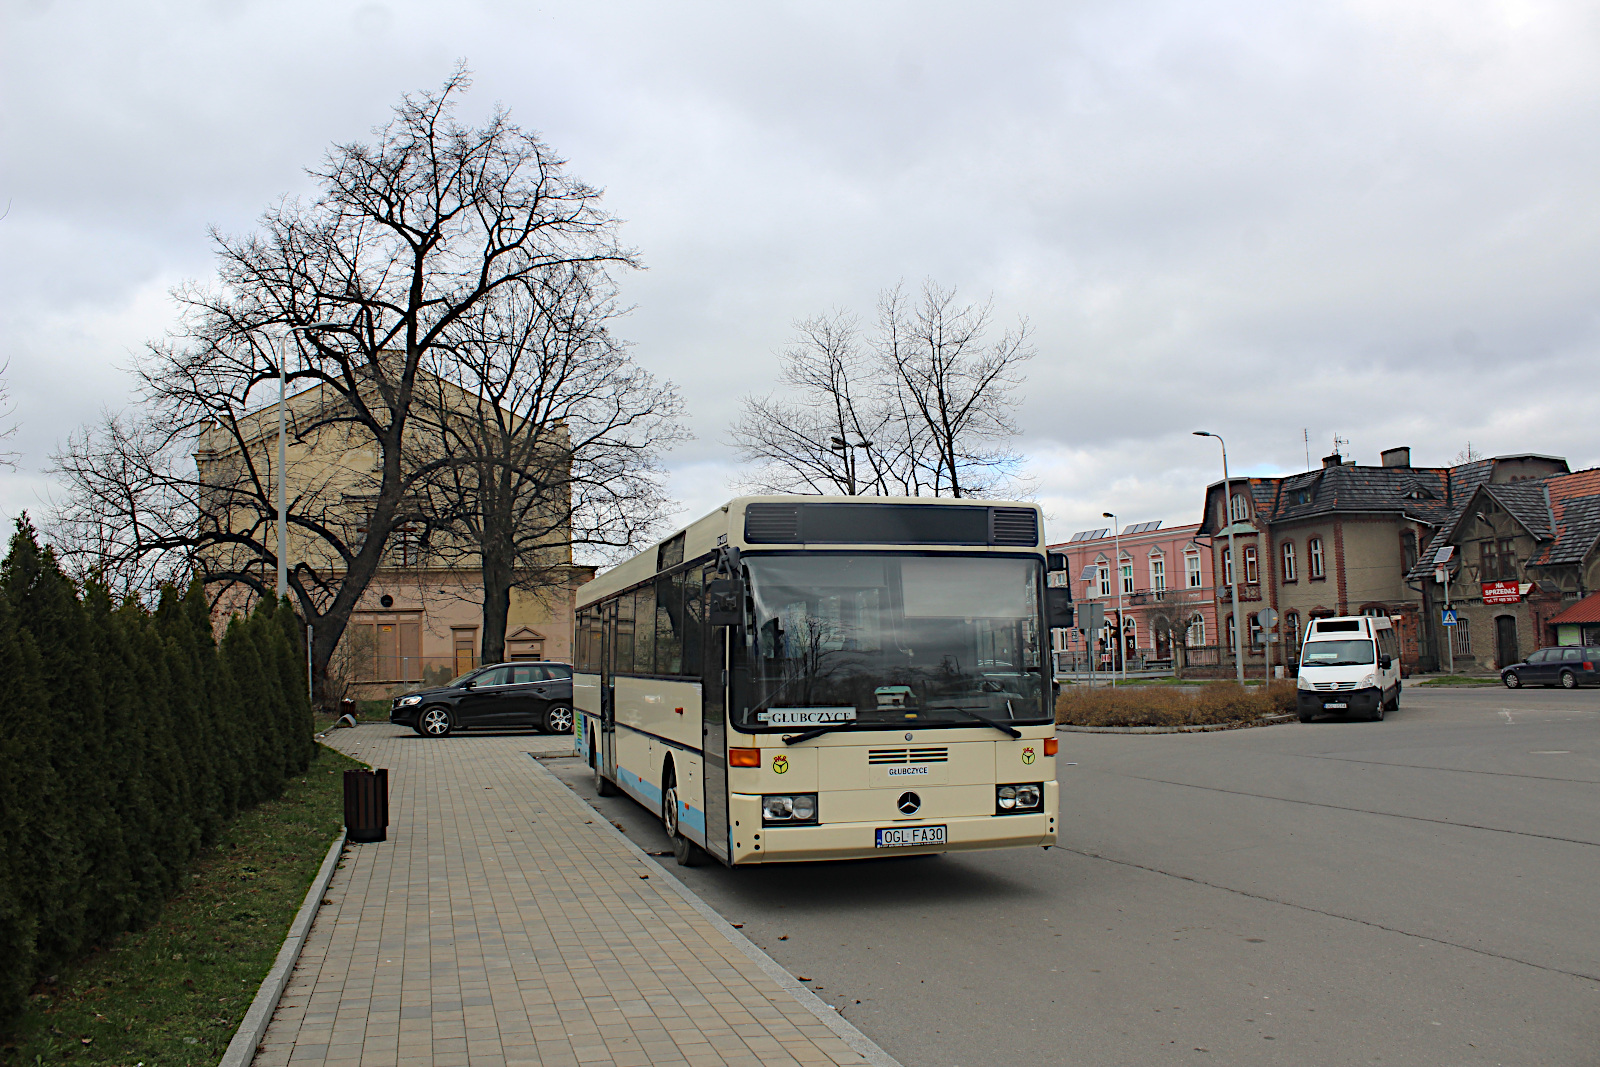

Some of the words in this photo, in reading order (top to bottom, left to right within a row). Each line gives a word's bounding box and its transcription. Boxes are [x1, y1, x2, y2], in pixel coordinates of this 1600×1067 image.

[889, 767, 928, 775] GŁUBCZYCE
[884, 830, 908, 843] OGL
[912, 828, 943, 841] FA30
